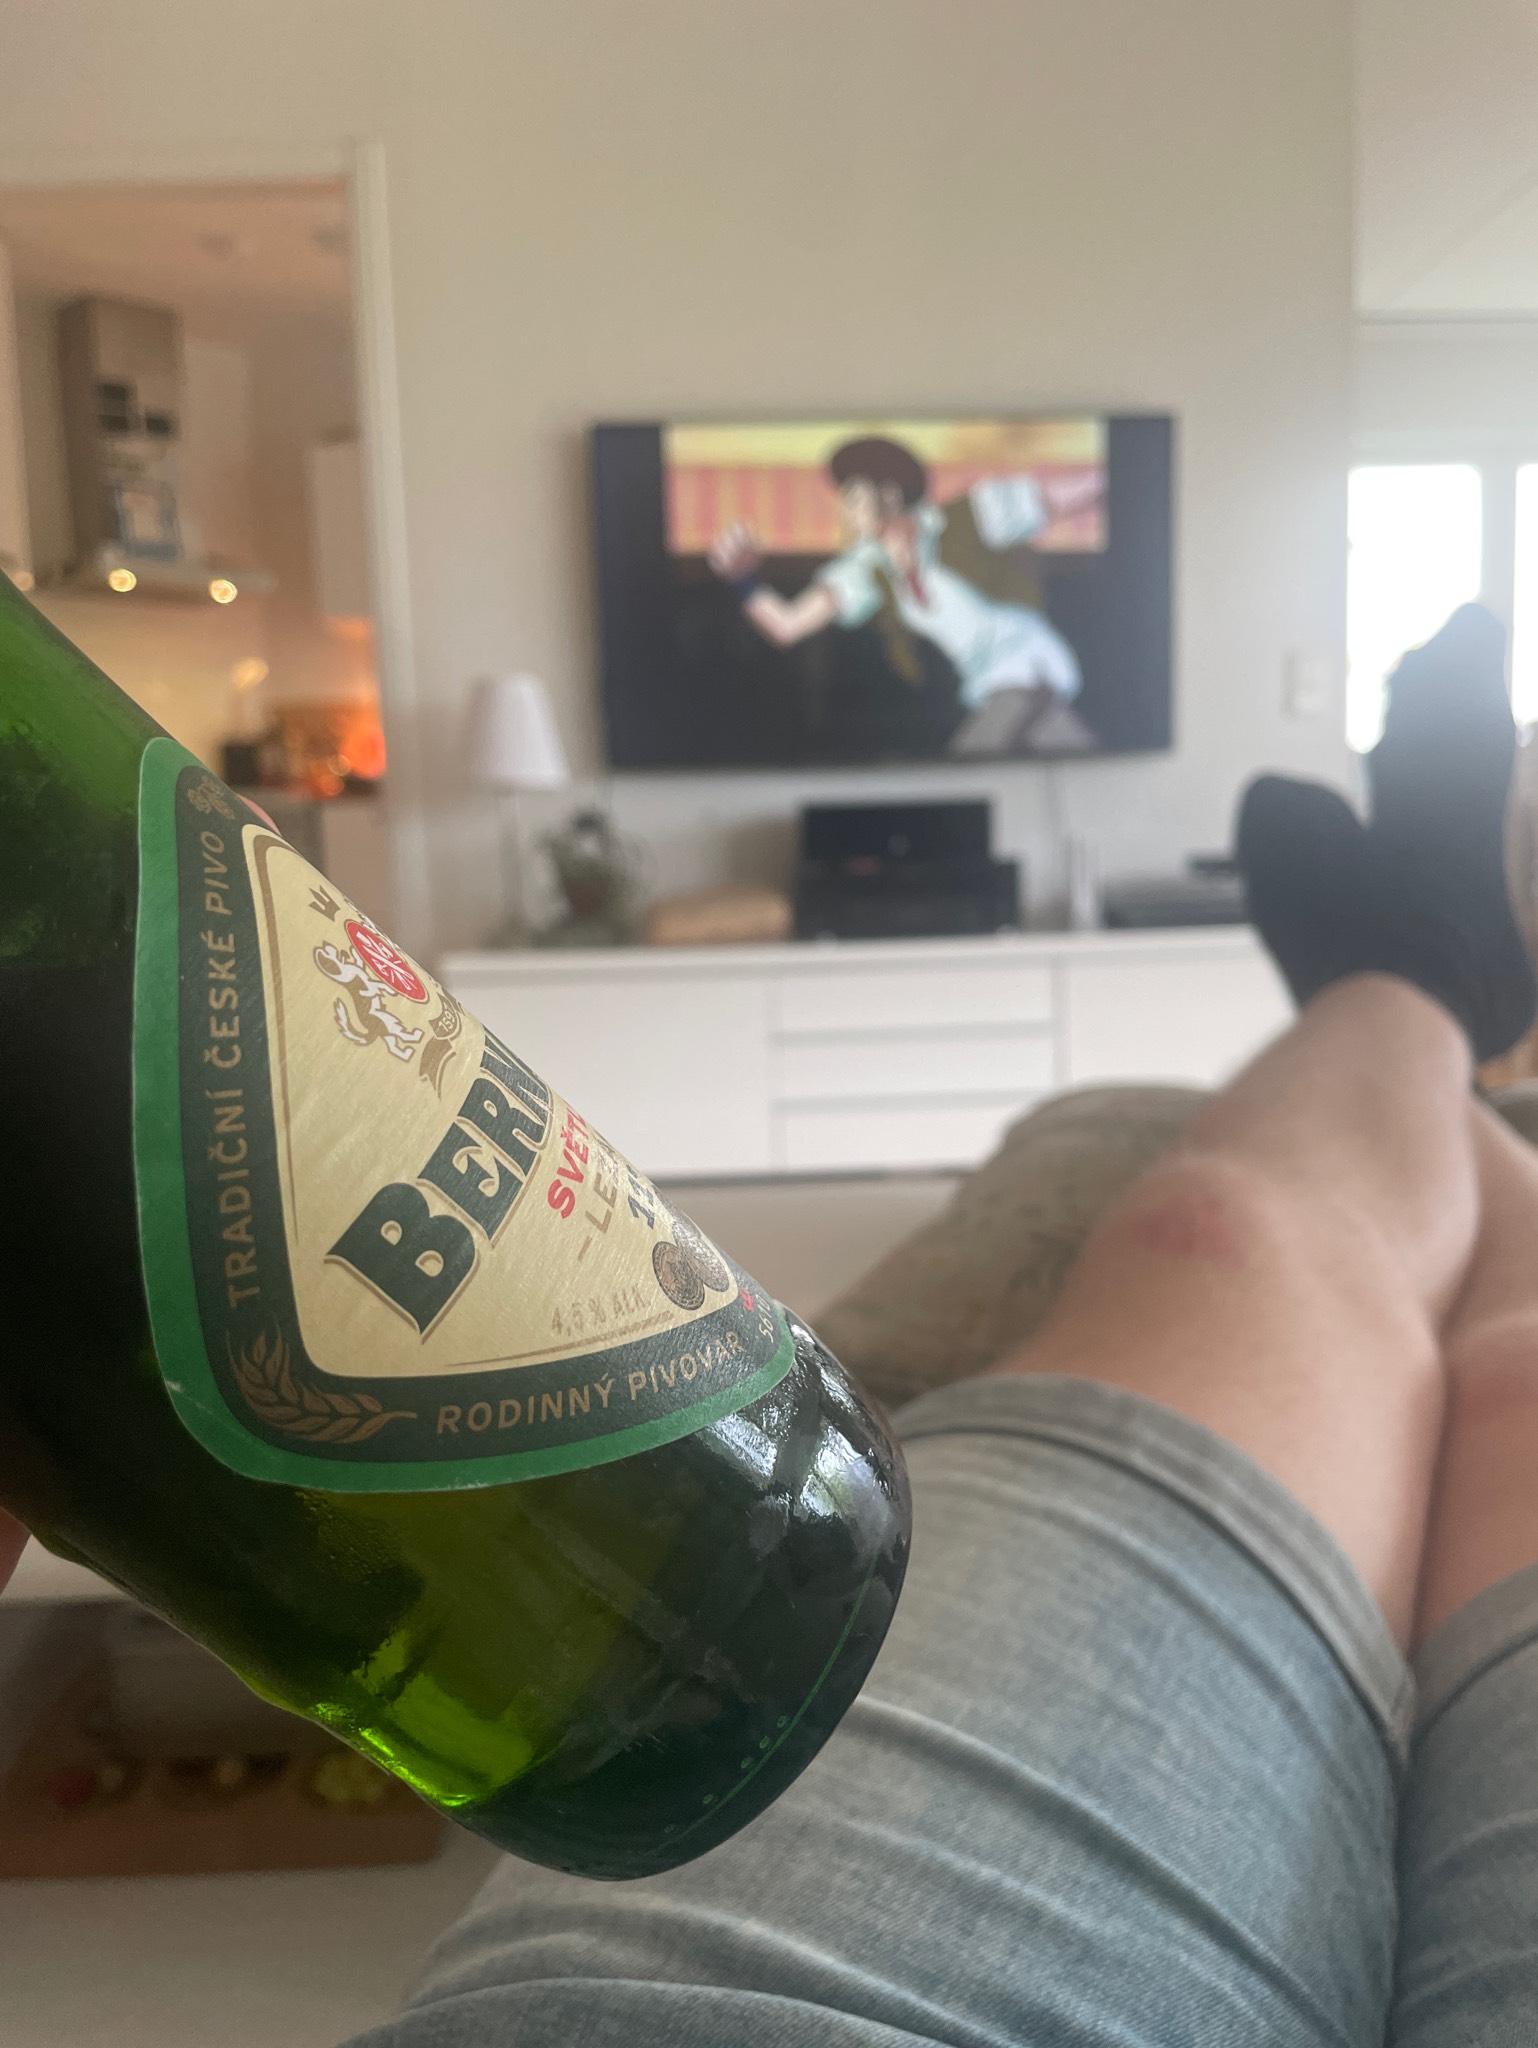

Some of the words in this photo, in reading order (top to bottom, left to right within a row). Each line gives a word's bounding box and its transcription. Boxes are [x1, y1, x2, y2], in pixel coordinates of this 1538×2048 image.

[200, 831, 233, 916] PIVO
[200, 929, 243, 1070] ČESKÉ
[205, 1087, 261, 1309] TRADIČNÍ
[322, 1022, 553, 1345] BERN
[436, 1372, 616, 1435] RODINNÝ
[627, 1329, 746, 1401] PIVOVAR
